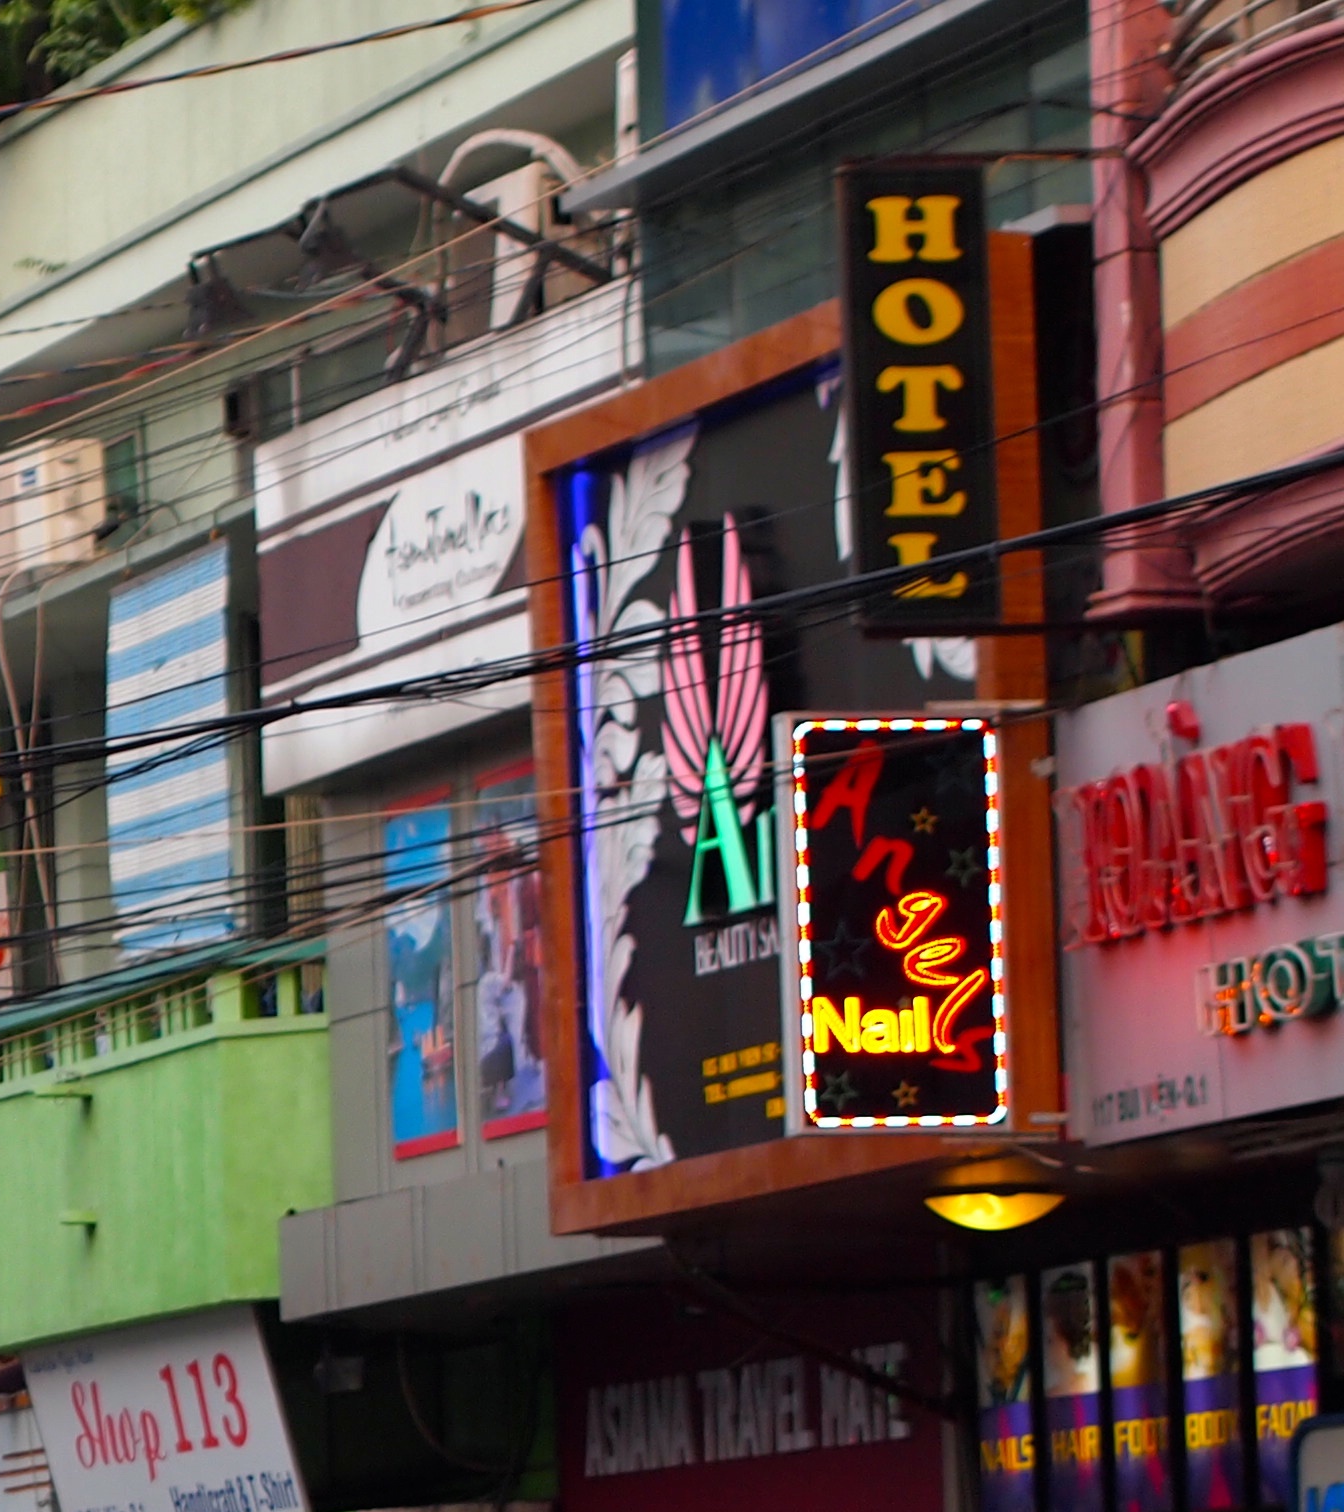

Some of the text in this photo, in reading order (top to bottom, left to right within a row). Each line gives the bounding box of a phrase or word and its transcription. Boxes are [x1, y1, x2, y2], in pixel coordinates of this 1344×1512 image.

[865, 193, 968, 600] HOTEL
[1196, 932, 1344, 1037] HOT
[812, 995, 931, 1054] Nail
[70, 1353, 249, 1483] Shop 113
[697, 1355, 817, 1463] TRAVEL
[1114, 1416, 1169, 1457] FOOT
[1185, 1409, 1239, 1450] BODY
[980, 1434, 1036, 1472] NAILS
[1052, 1425, 1101, 1462] HAIR
